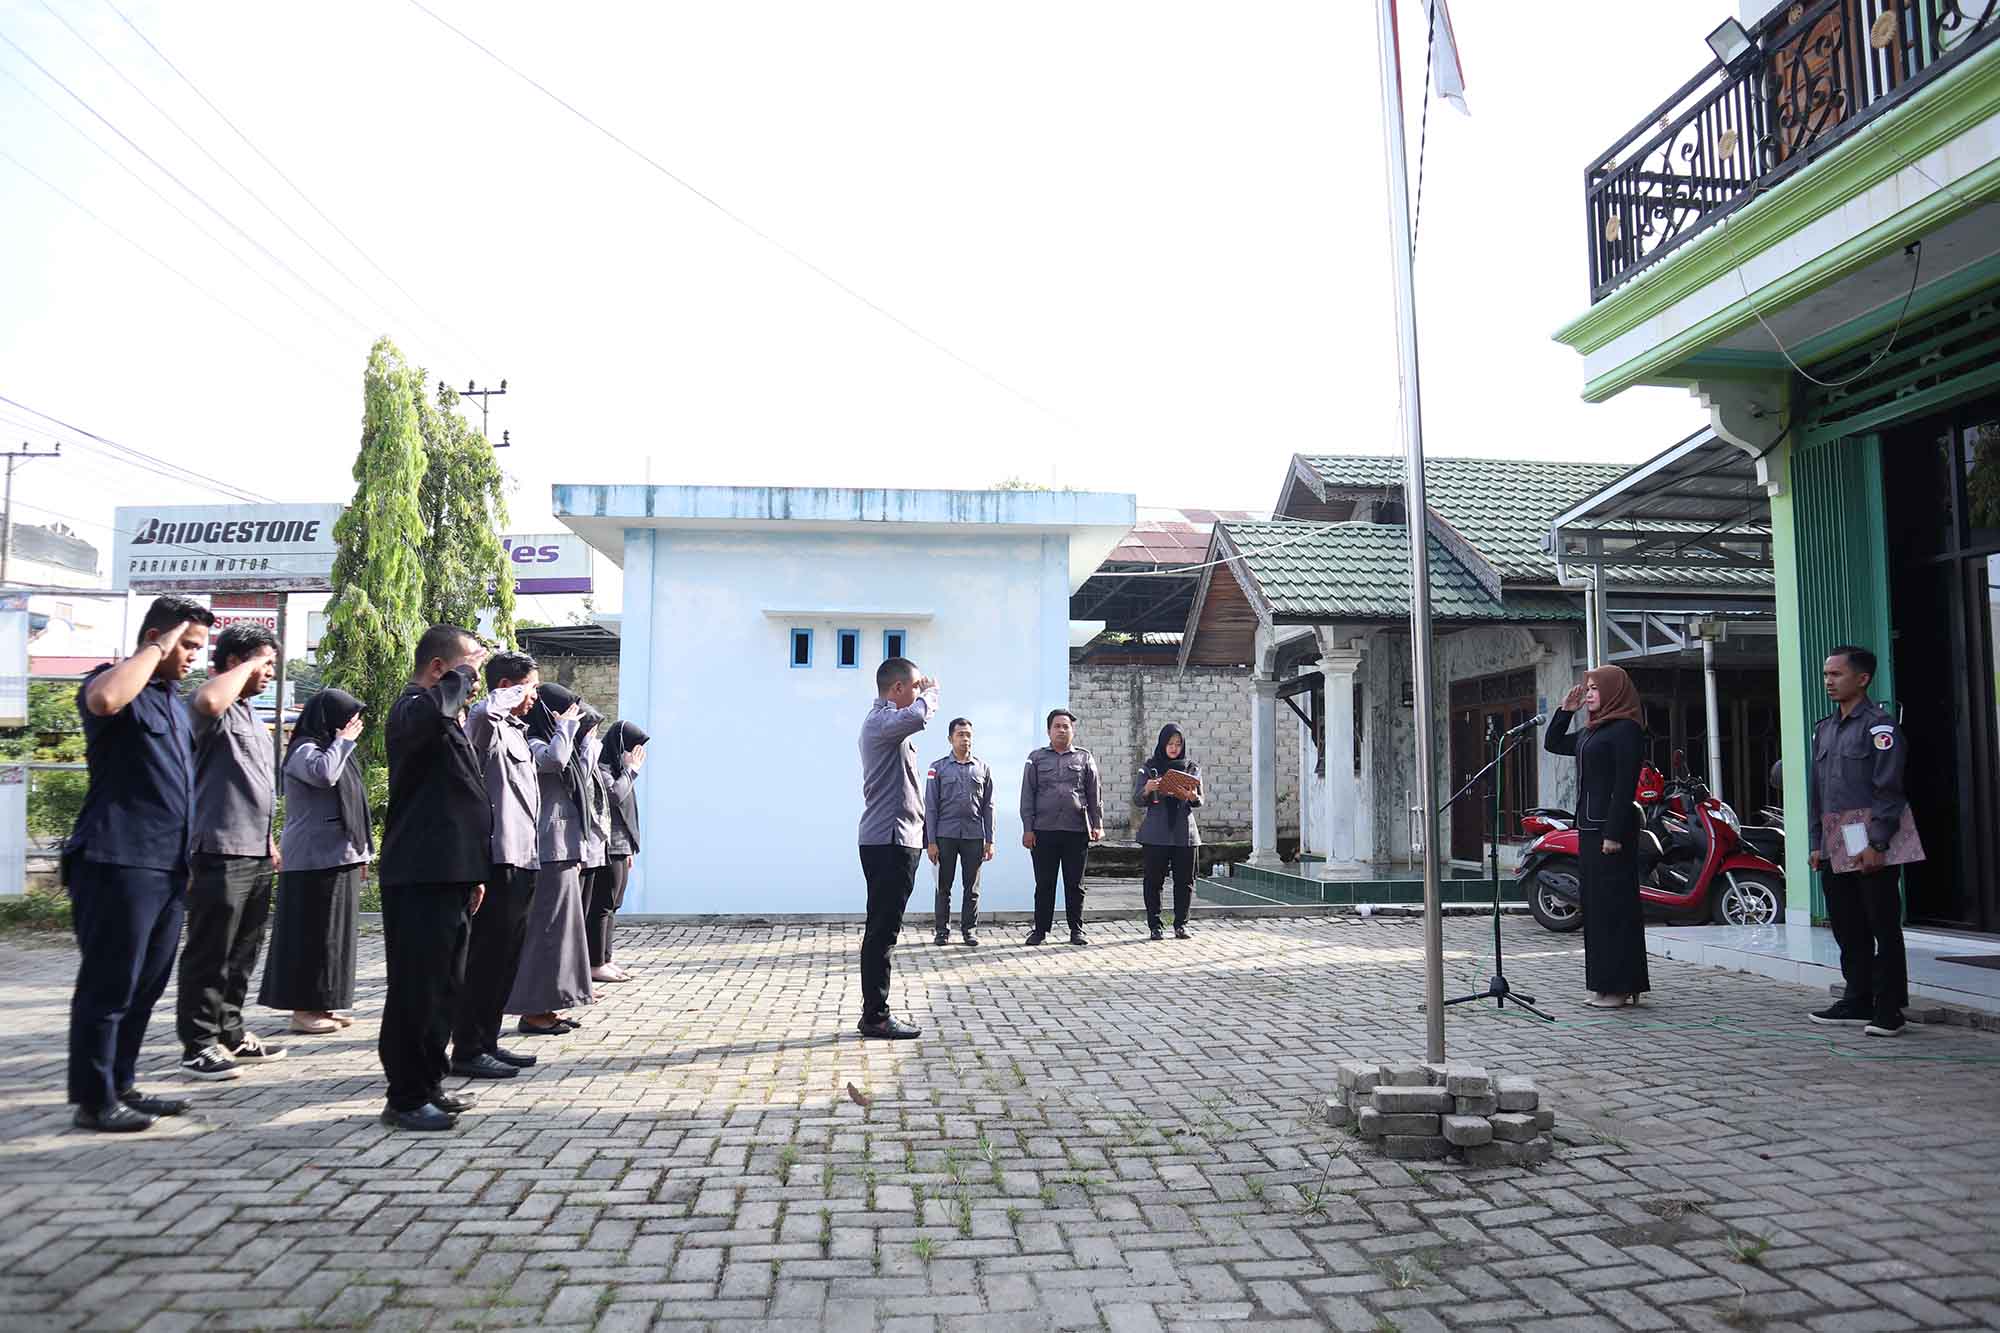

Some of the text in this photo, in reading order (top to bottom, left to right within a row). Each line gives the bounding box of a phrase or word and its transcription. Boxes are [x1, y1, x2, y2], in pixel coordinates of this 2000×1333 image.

[131, 518, 321, 545] BRIDGESTONE
[129, 558, 270, 573] PARINGIN MOTOR
